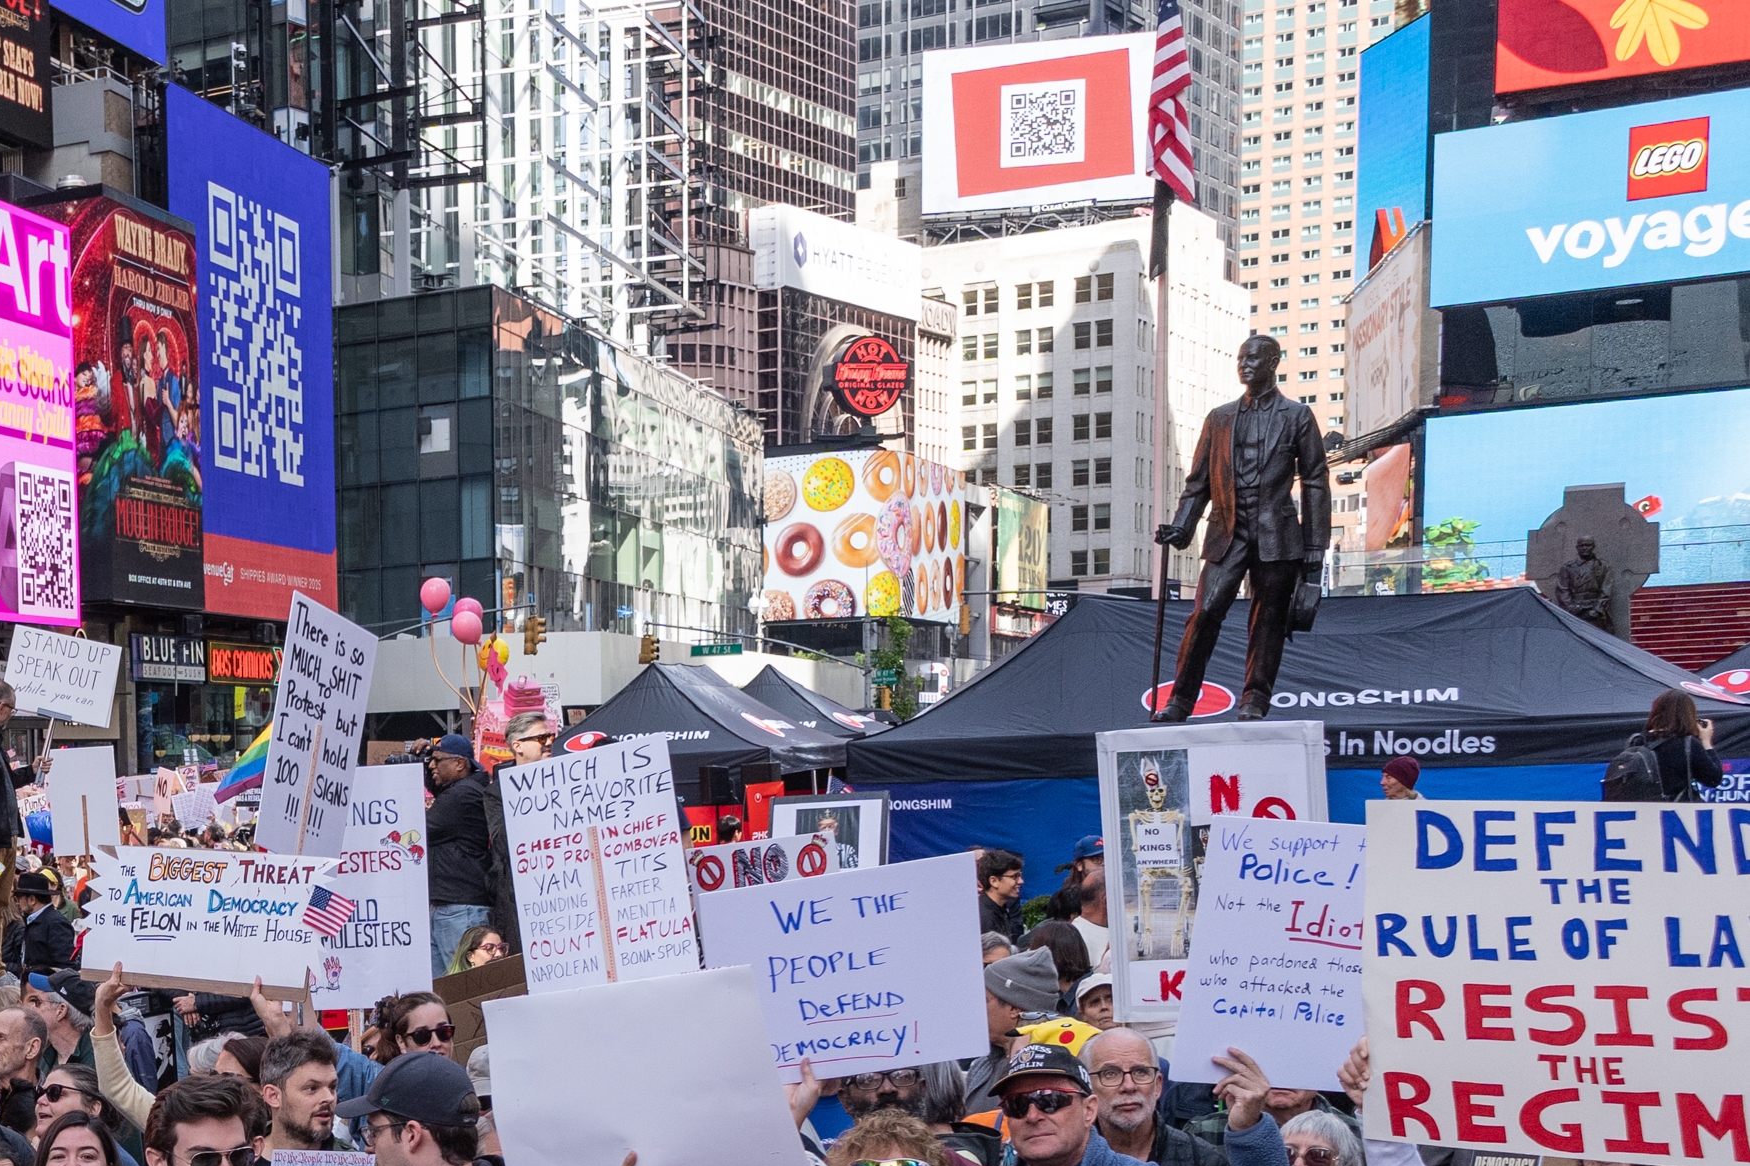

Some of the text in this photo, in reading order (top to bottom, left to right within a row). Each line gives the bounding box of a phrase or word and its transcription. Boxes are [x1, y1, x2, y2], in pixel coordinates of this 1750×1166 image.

[3, 39, 34, 78] SEATS
[18, 80, 43, 113] NOW!
[1637, 141, 1703, 176] LEGO
[114, 265, 189, 311] HAROLD ZIDLER
[855, 344, 887, 359] HOT
[115, 498, 200, 547] MOULIN ROUGE!
[240, 567, 322, 590] SHIPPIES AWARD WINNER 2025
[21, 630, 110, 665] STAND UP
[212, 650, 273, 678] DOS CAMINOS
[714, 646, 723, 654] 47
[14, 654, 101, 690] SPEAK OUT
[290, 643, 362, 700] MUCH SHIT
[14, 682, 94, 706] while you can
[1339, 730, 1496, 756] In Noodles
[275, 755, 349, 807] 100 SIGNS
[509, 744, 651, 793] WHICH IS
[509, 769, 672, 817] YOUR FAVORITE
[553, 800, 636, 830] NAME?
[121, 854, 316, 884] THE BIGGEST THREAT
[108, 879, 298, 917] TO AMERICAN DEMOCRACY
[1541, 878, 1631, 905] THE
[95, 913, 105, 925] IS
[112, 914, 126, 927] THE
[130, 907, 181, 933] FELON
[187, 920, 197, 931] IN
[204, 921, 219, 933] THE
[770, 891, 909, 934] WE THE
[1376, 913, 1628, 961] RULE OF
[768, 946, 891, 994] PEOPLE
[1212, 999, 1344, 1026] Capital Police
[1009, 1061, 1044, 1074] DUBLIN
